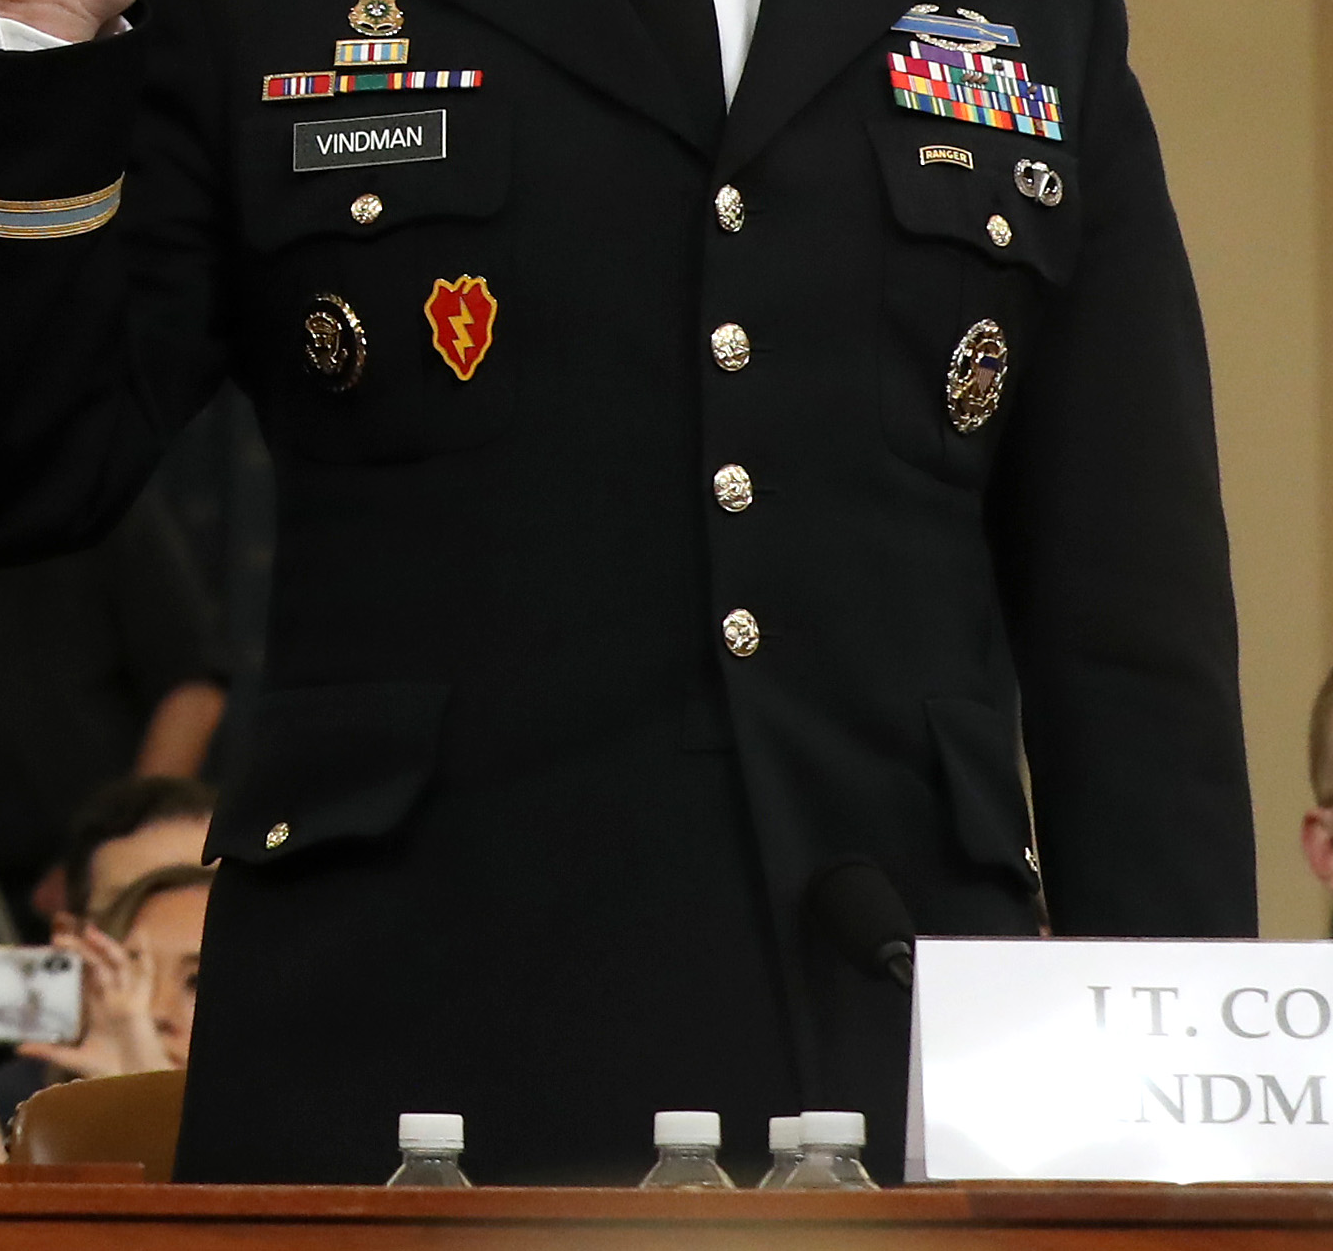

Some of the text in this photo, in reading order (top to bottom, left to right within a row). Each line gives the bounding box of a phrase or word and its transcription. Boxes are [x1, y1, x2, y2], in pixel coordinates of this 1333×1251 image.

[316, 125, 423, 155] VINDMAN
[925, 149, 968, 163] RANGER
[1221, 987, 1331, 1039] CO
